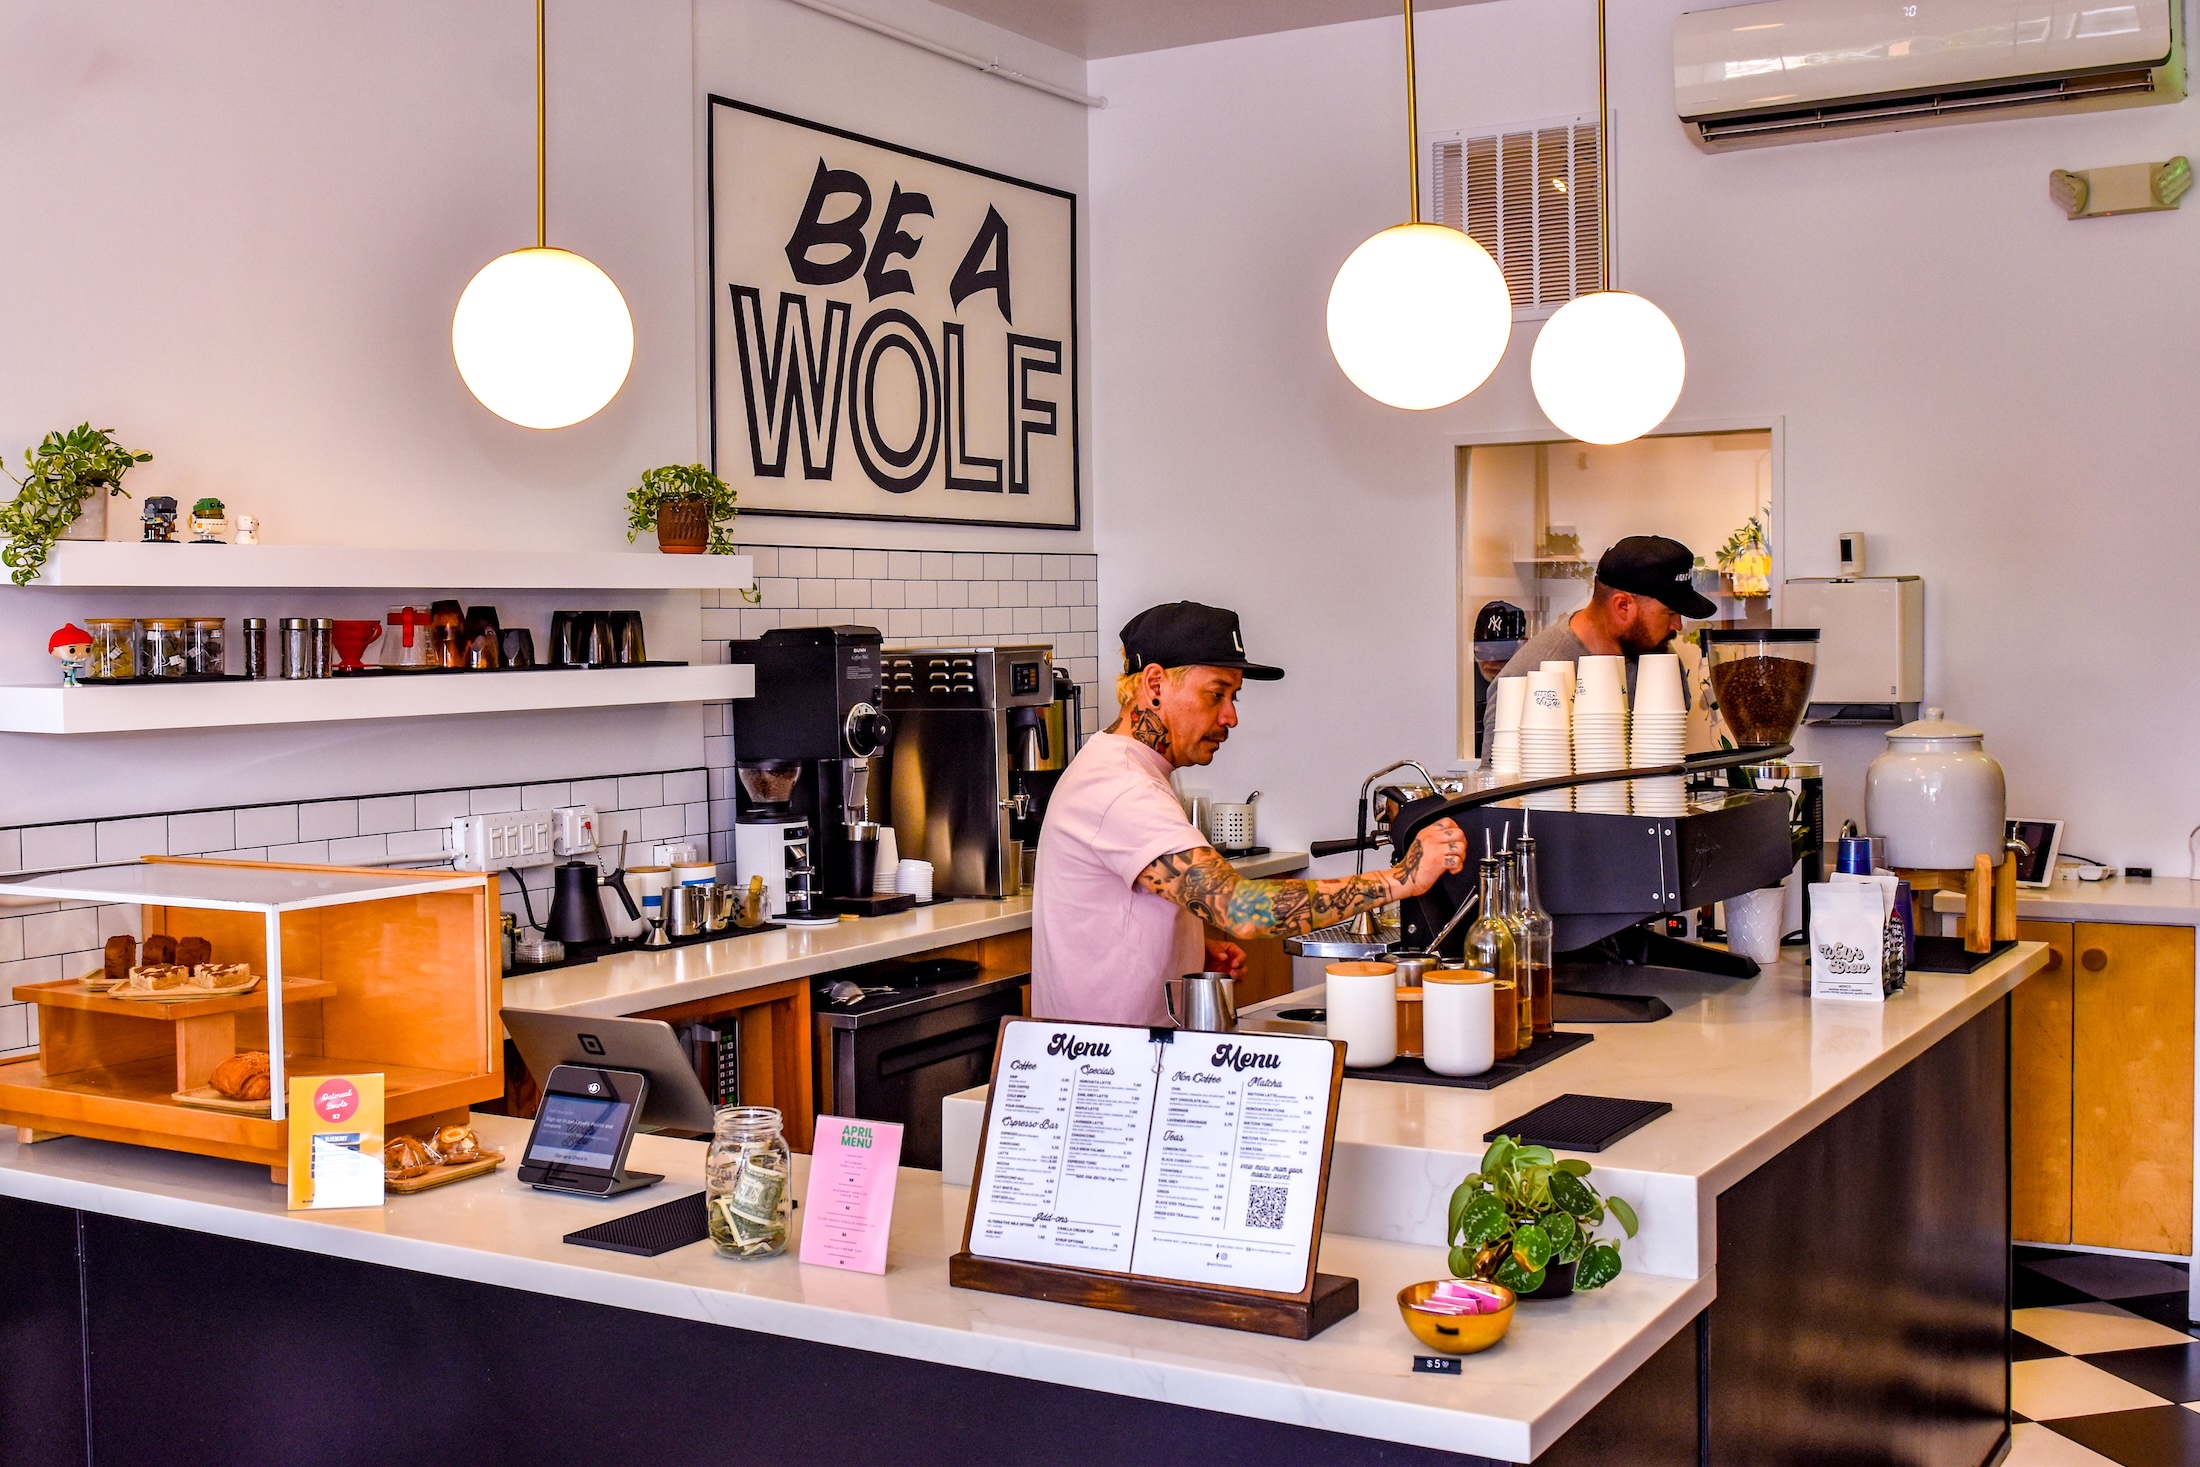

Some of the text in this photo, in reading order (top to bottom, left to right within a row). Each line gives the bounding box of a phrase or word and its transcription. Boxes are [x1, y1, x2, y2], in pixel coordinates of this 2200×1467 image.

[1902, 5, 1917, 17] 70
[785, 156, 1013, 327] BE A
[728, 283, 1062, 494] WOLF
[1487, 614, 1503, 632] NY
[1668, 919, 1677, 928] 50
[1828, 959, 1871, 974] Brew
[1047, 1033, 1112, 1060] Menu
[1211, 1043, 1281, 1072] Menu
[1010, 1059, 1037, 1071] Coffee
[1080, 1064, 1116, 1076] Specials
[1172, 1071, 1222, 1084] Non Coffee
[1247, 1076, 1283, 1089] Matcha
[321, 1089, 353, 1101] Oatmeal
[325, 1101, 349, 1110] Bowls
[1001, 1116, 1038, 1130] Espresso
[1039, 1118, 1059, 1130] Bar
[842, 1125, 873, 1139] APRIL
[1163, 1130, 1185, 1142] Teas
[841, 1136, 872, 1149] MENU
[1032, 1212, 1069, 1223] Add-ons
